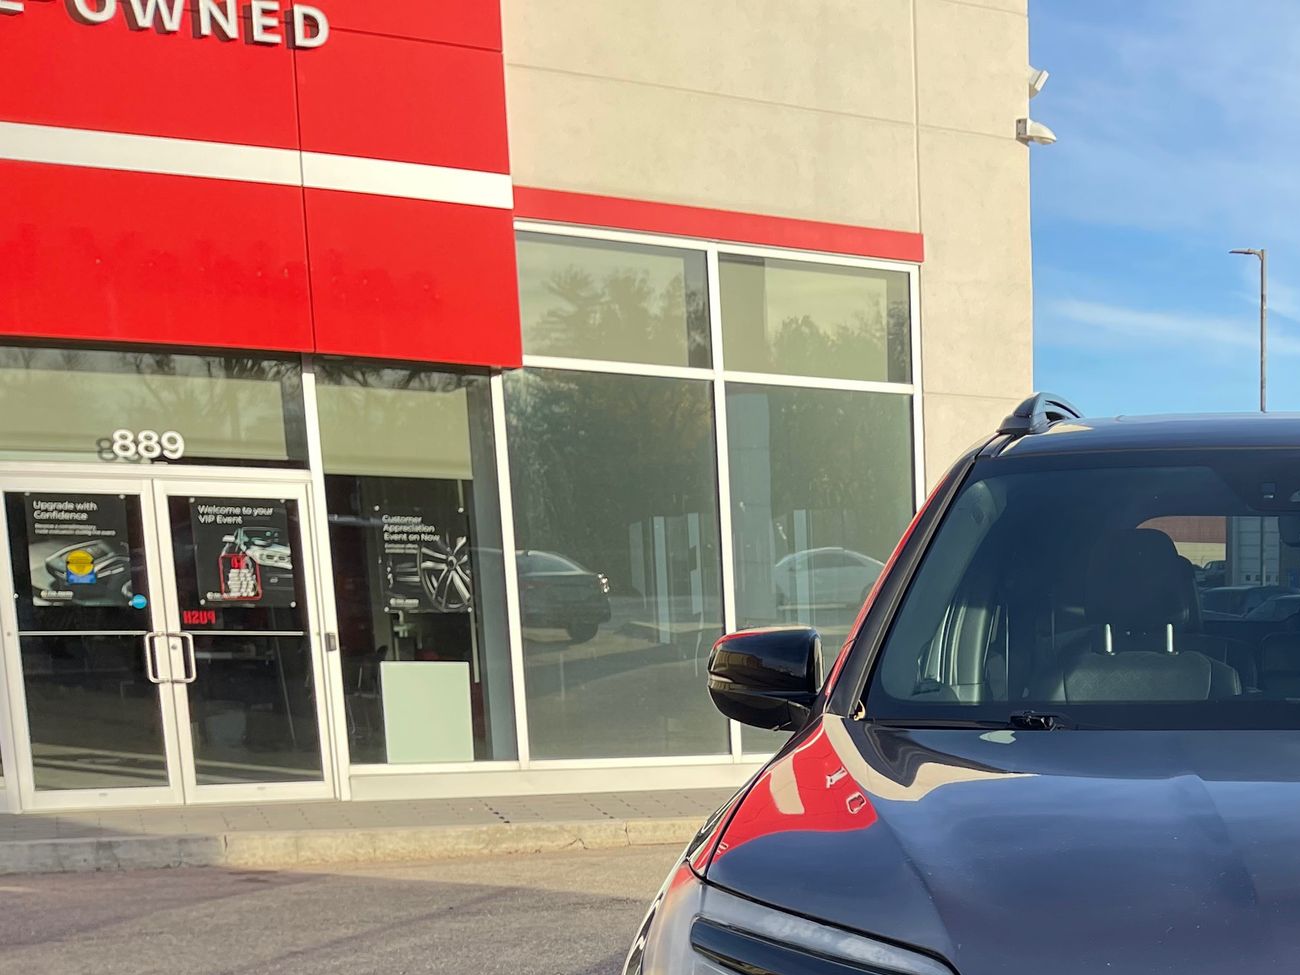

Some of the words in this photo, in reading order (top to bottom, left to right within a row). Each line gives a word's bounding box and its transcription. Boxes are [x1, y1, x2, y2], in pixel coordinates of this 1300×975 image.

[112, 428, 185, 460] 889
[33, 500, 75, 511] Upgrade
[75, 501, 98, 511] with
[33, 510, 88, 520] Confidence
[197, 505, 241, 515] Welcome
[241, 506, 252, 515] to
[252, 507, 274, 517] your
[198, 514, 215, 524] VIP
[216, 515, 243, 524] Event
[382, 514, 422, 524] Customer
[383, 523, 435, 533] Appreciation
[384, 531, 407, 541] Event
[408, 533, 420, 541] on
[420, 533, 440, 542] Now
